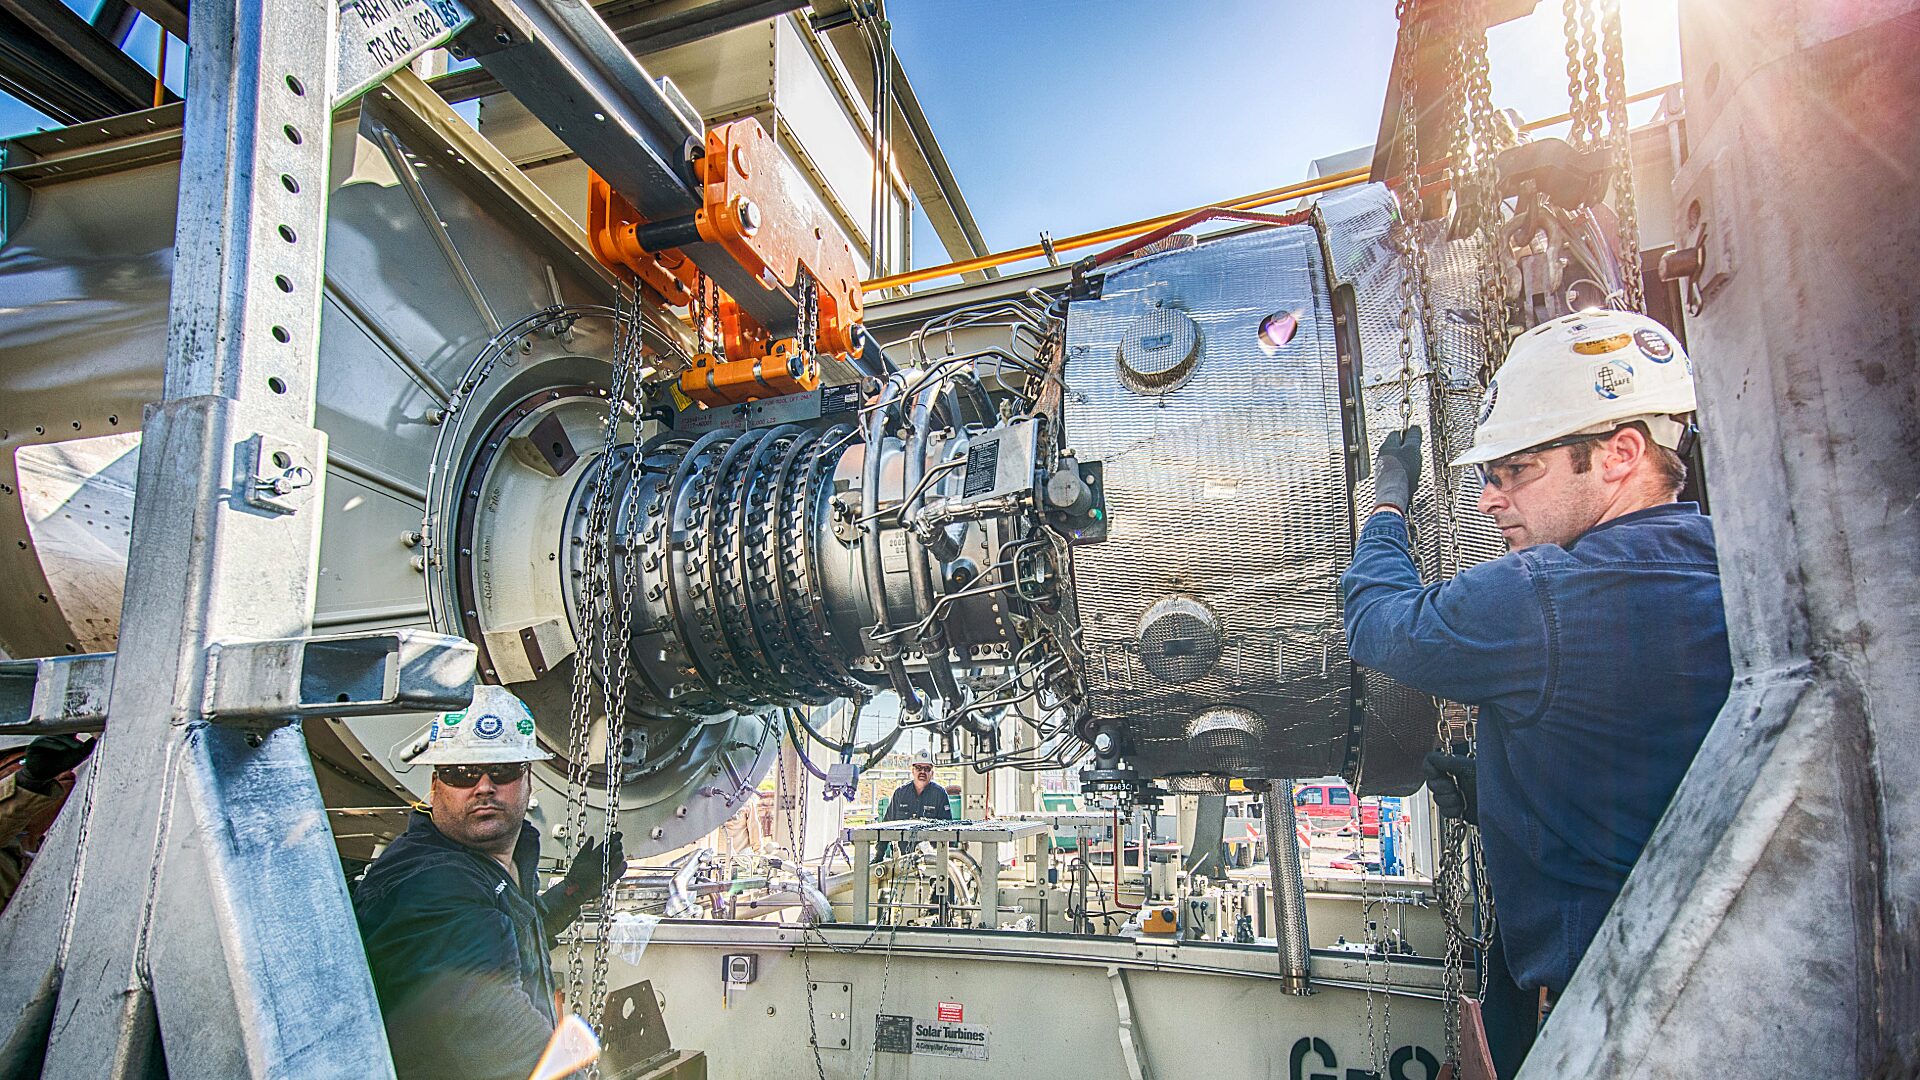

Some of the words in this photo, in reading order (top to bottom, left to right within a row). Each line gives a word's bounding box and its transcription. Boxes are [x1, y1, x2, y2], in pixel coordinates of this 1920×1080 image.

[366, 36, 394, 68] 173
[385, 26, 412, 57] KG
[413, 9, 441, 40] 382
[433, 0, 461, 28] LBS
[1613, 377, 1631, 387] SAFE
[916, 1024, 942, 1037] Solar
[943, 1026, 985, 1041] Turbines
[943, 1045, 963, 1053] Company
